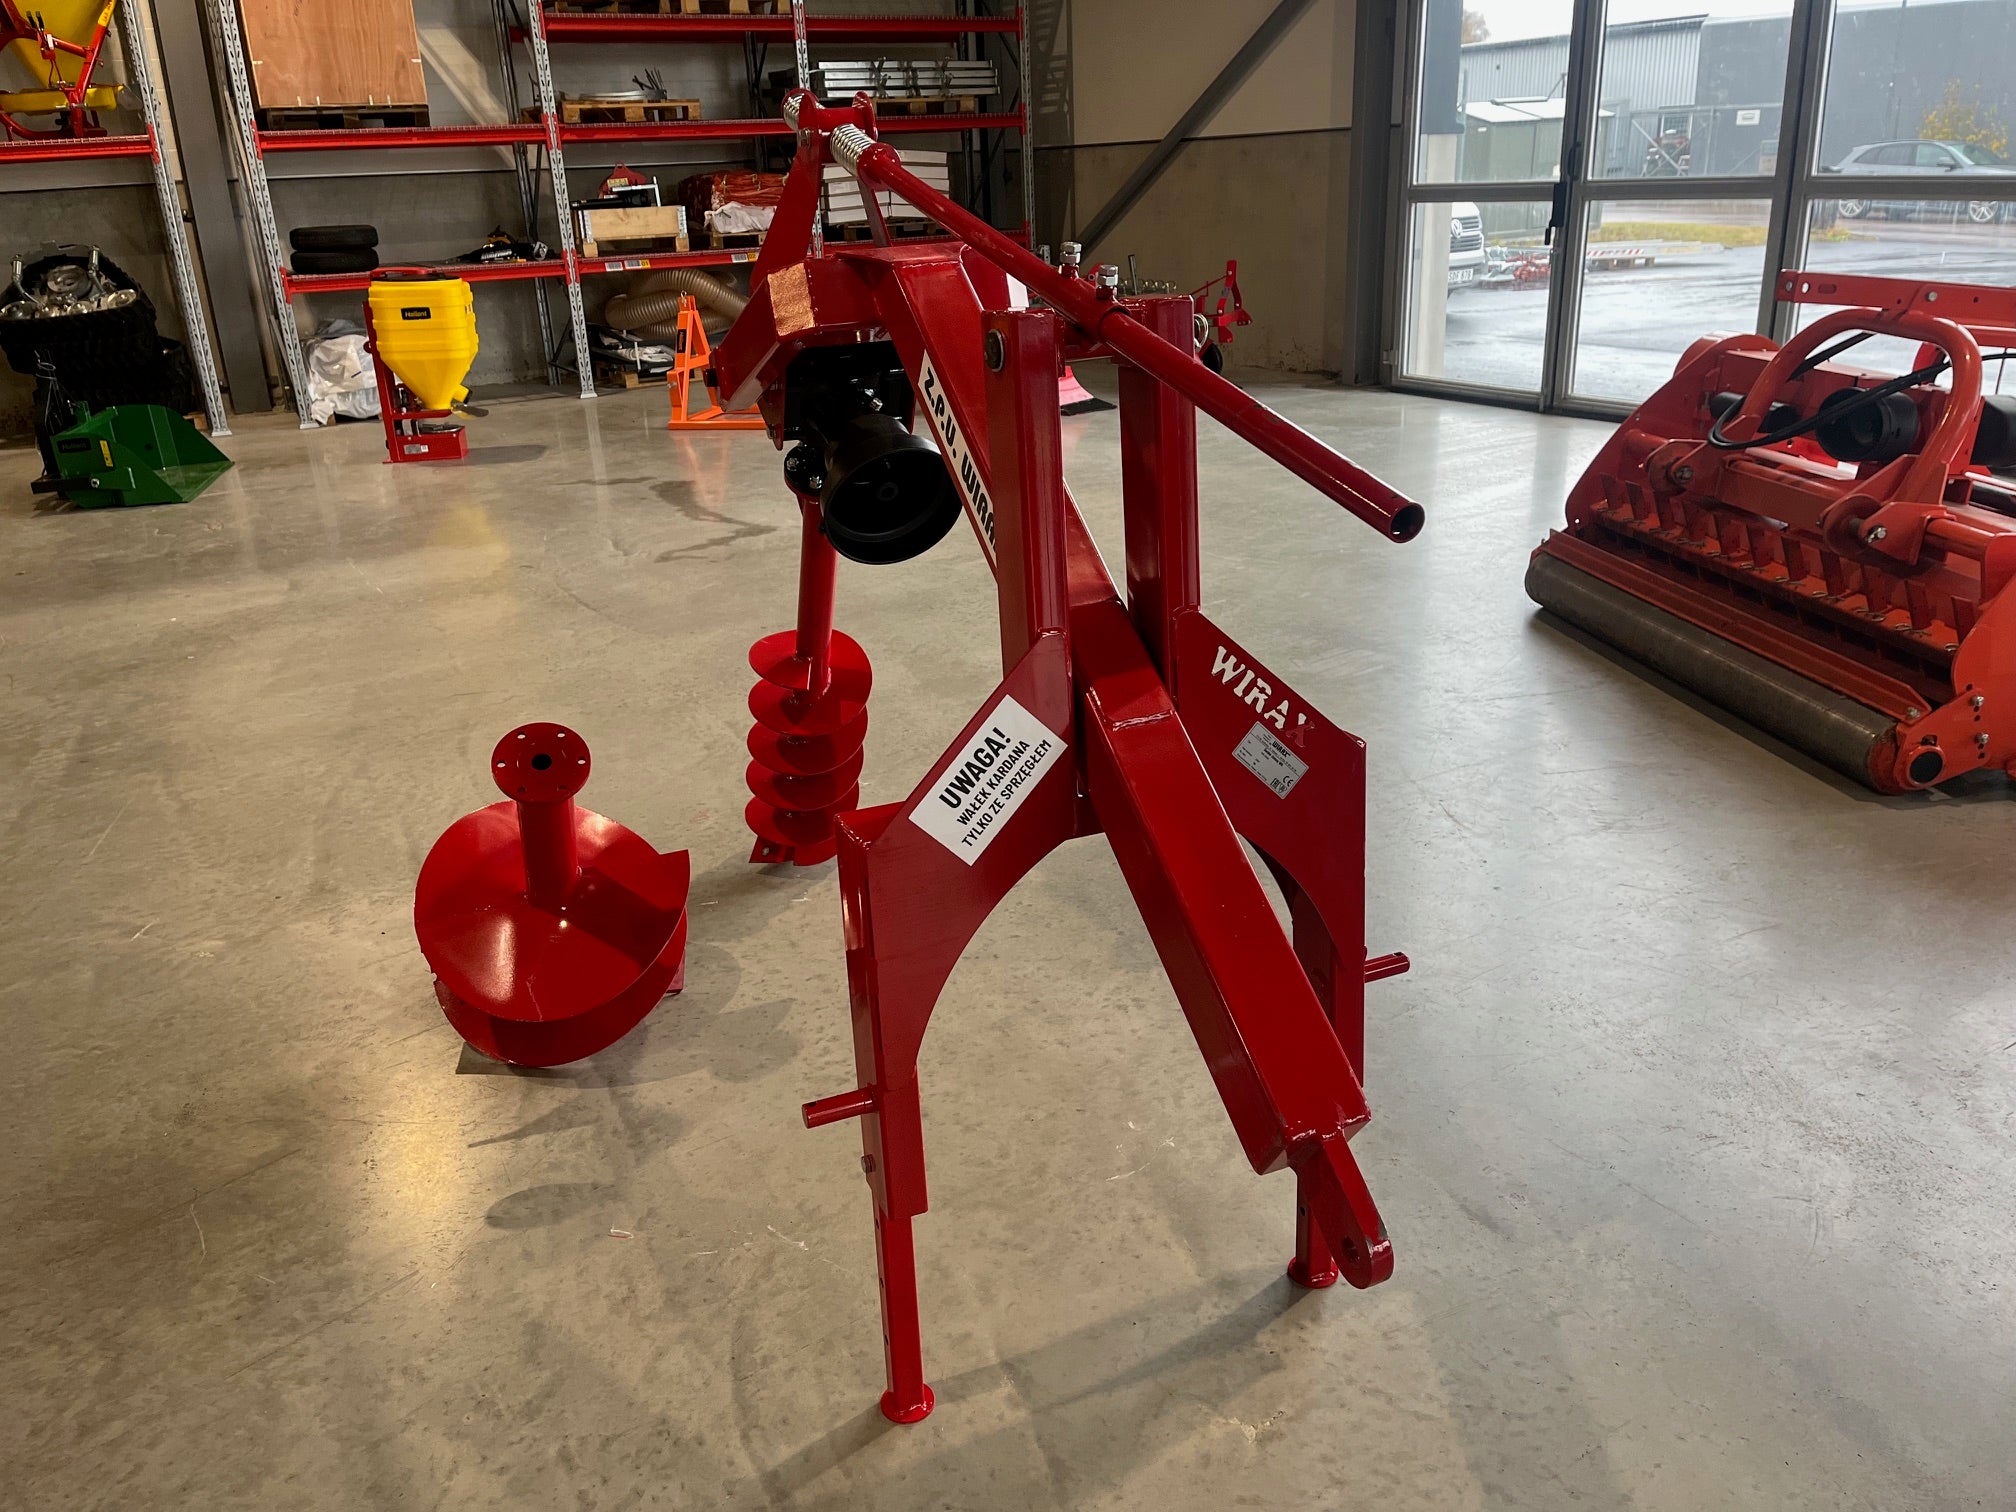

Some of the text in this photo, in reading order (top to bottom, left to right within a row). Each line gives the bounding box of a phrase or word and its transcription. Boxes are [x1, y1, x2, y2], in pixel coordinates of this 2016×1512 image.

[924, 366, 997, 550] Z.P.U. WIRA
[938, 726, 1011, 809] UWAGA!
[956, 740, 1031, 826] WAŁEK KARDANA
[961, 739, 1052, 847] TYLKO ZE SPRZĘGŁEM
